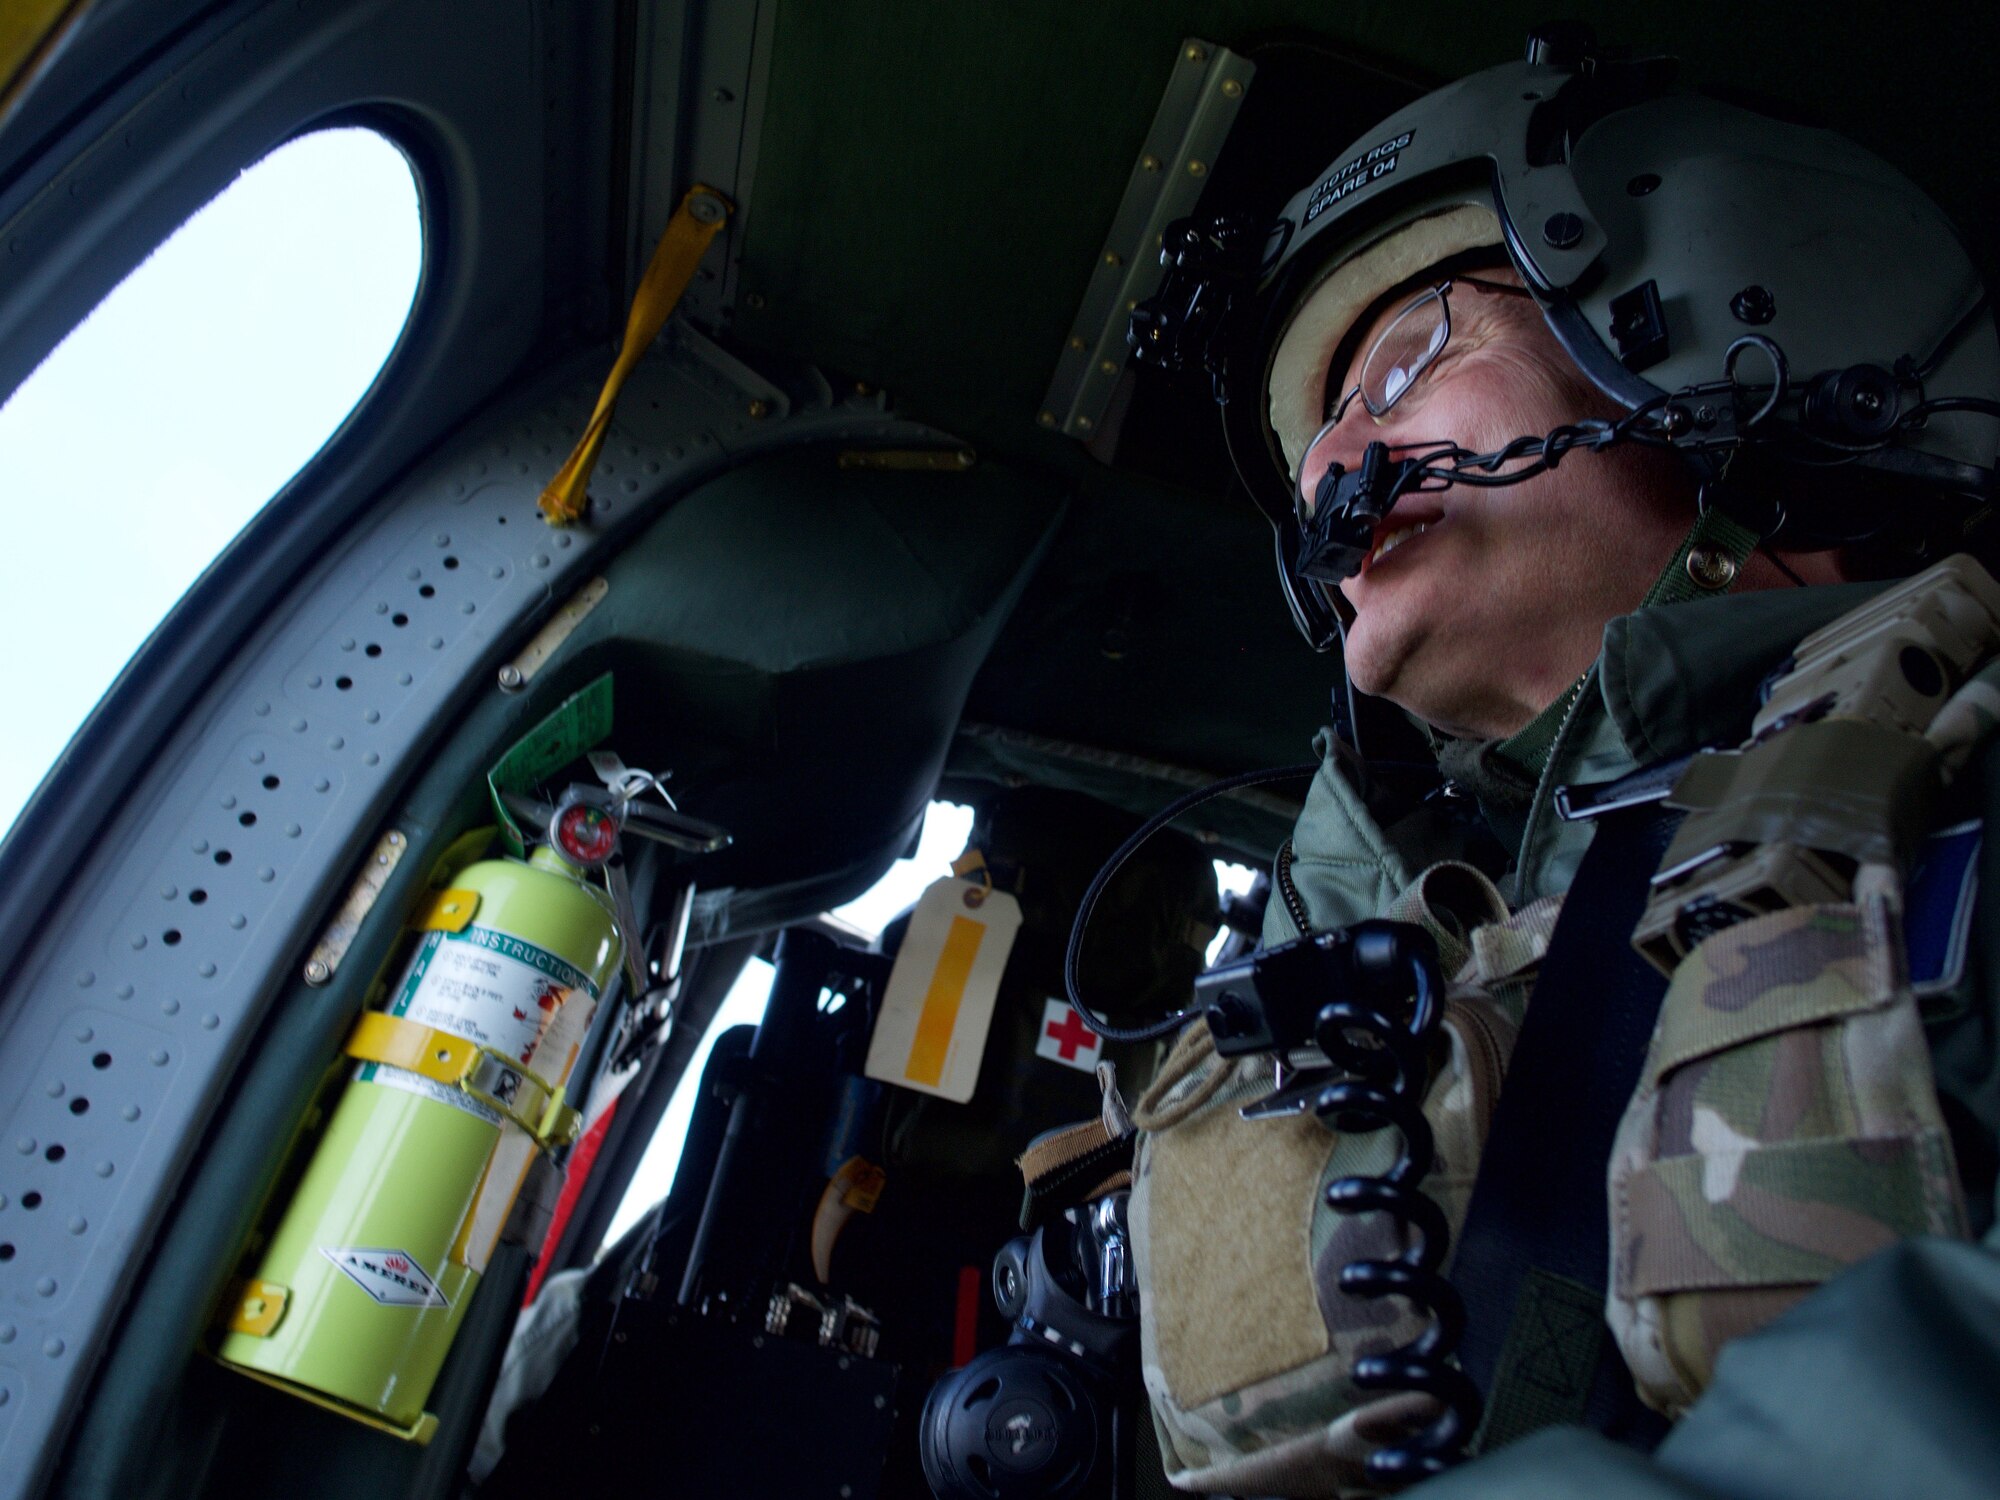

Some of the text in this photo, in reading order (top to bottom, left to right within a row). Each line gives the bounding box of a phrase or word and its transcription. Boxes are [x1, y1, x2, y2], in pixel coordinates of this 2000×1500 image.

[1307, 156, 1397, 220] SPARE 04
[1309, 133, 1411, 203] 210TH RQS
[470, 928, 590, 991] INSTRUCTIONS
